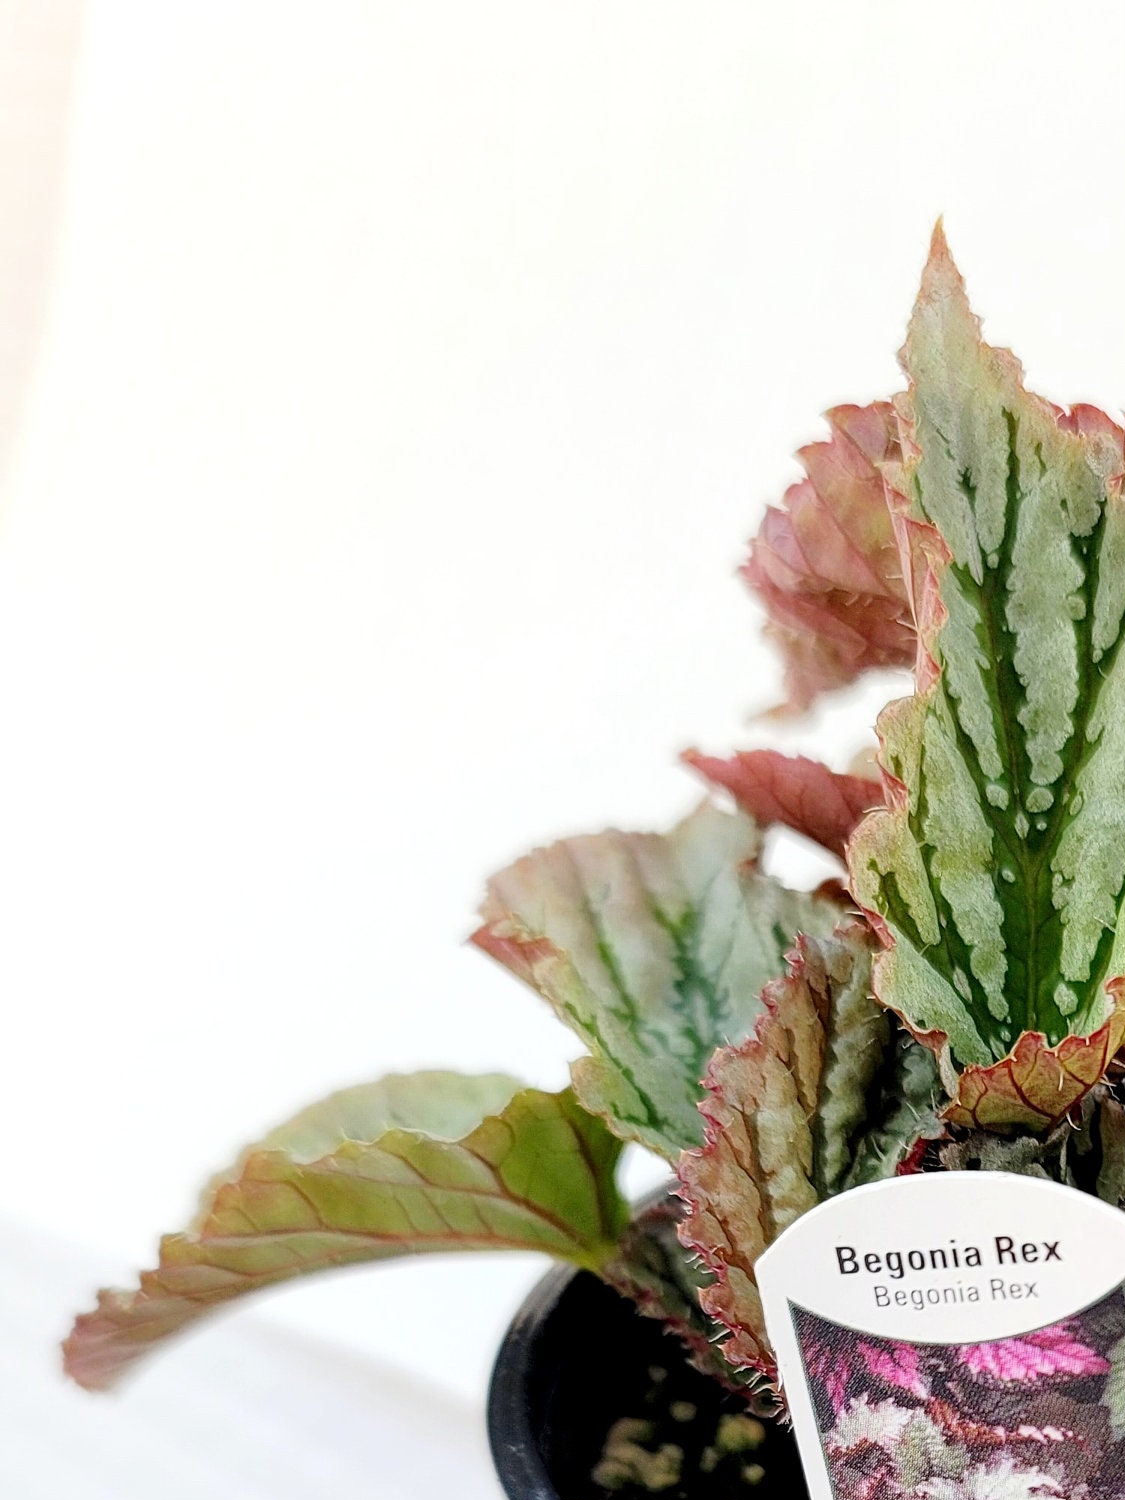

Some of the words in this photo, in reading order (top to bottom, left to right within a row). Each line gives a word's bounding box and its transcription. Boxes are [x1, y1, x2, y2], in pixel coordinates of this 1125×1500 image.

[835, 1239, 982, 1279] Begonia
[994, 1236, 1064, 1266] Rex
[873, 1282, 980, 1311] Begonia
[990, 1278, 1040, 1301] Rex
